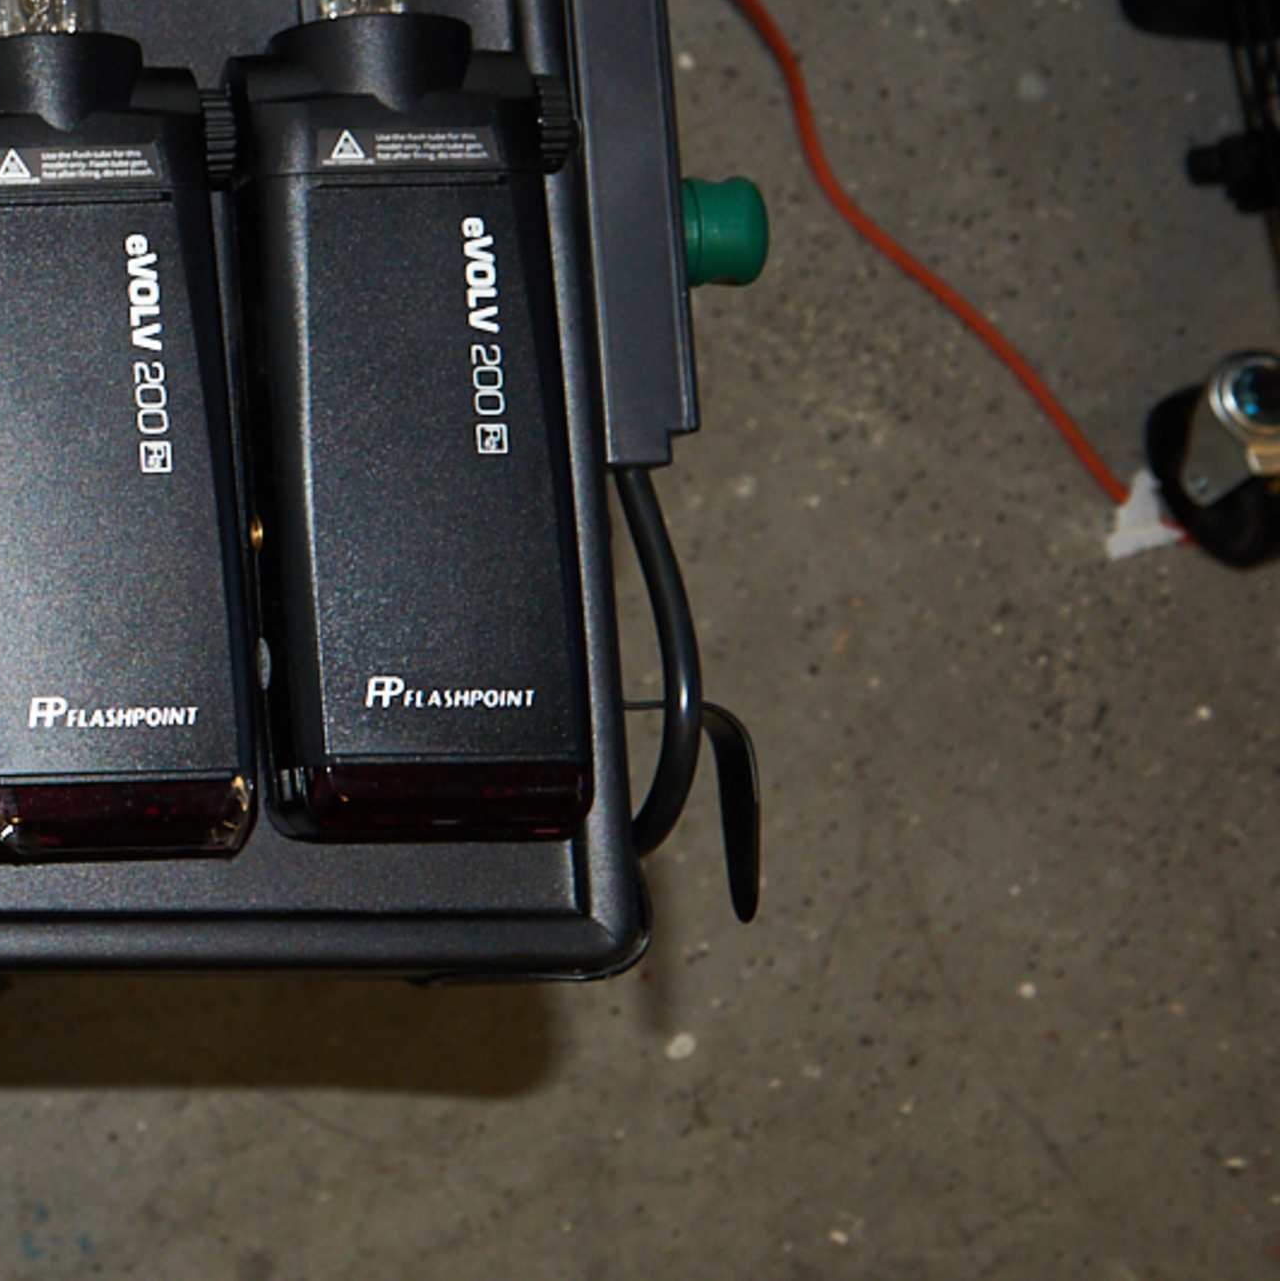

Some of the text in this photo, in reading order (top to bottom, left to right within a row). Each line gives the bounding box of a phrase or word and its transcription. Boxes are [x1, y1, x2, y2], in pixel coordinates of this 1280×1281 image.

[124, 234, 163, 351] eVOLV
[461, 217, 500, 334] eVOLV
[134, 361, 169, 434] 200
[470, 344, 505, 415] 200
[67, 706, 199, 728] FLASHPOINT
[404, 689, 536, 708] FLASHPOINT
